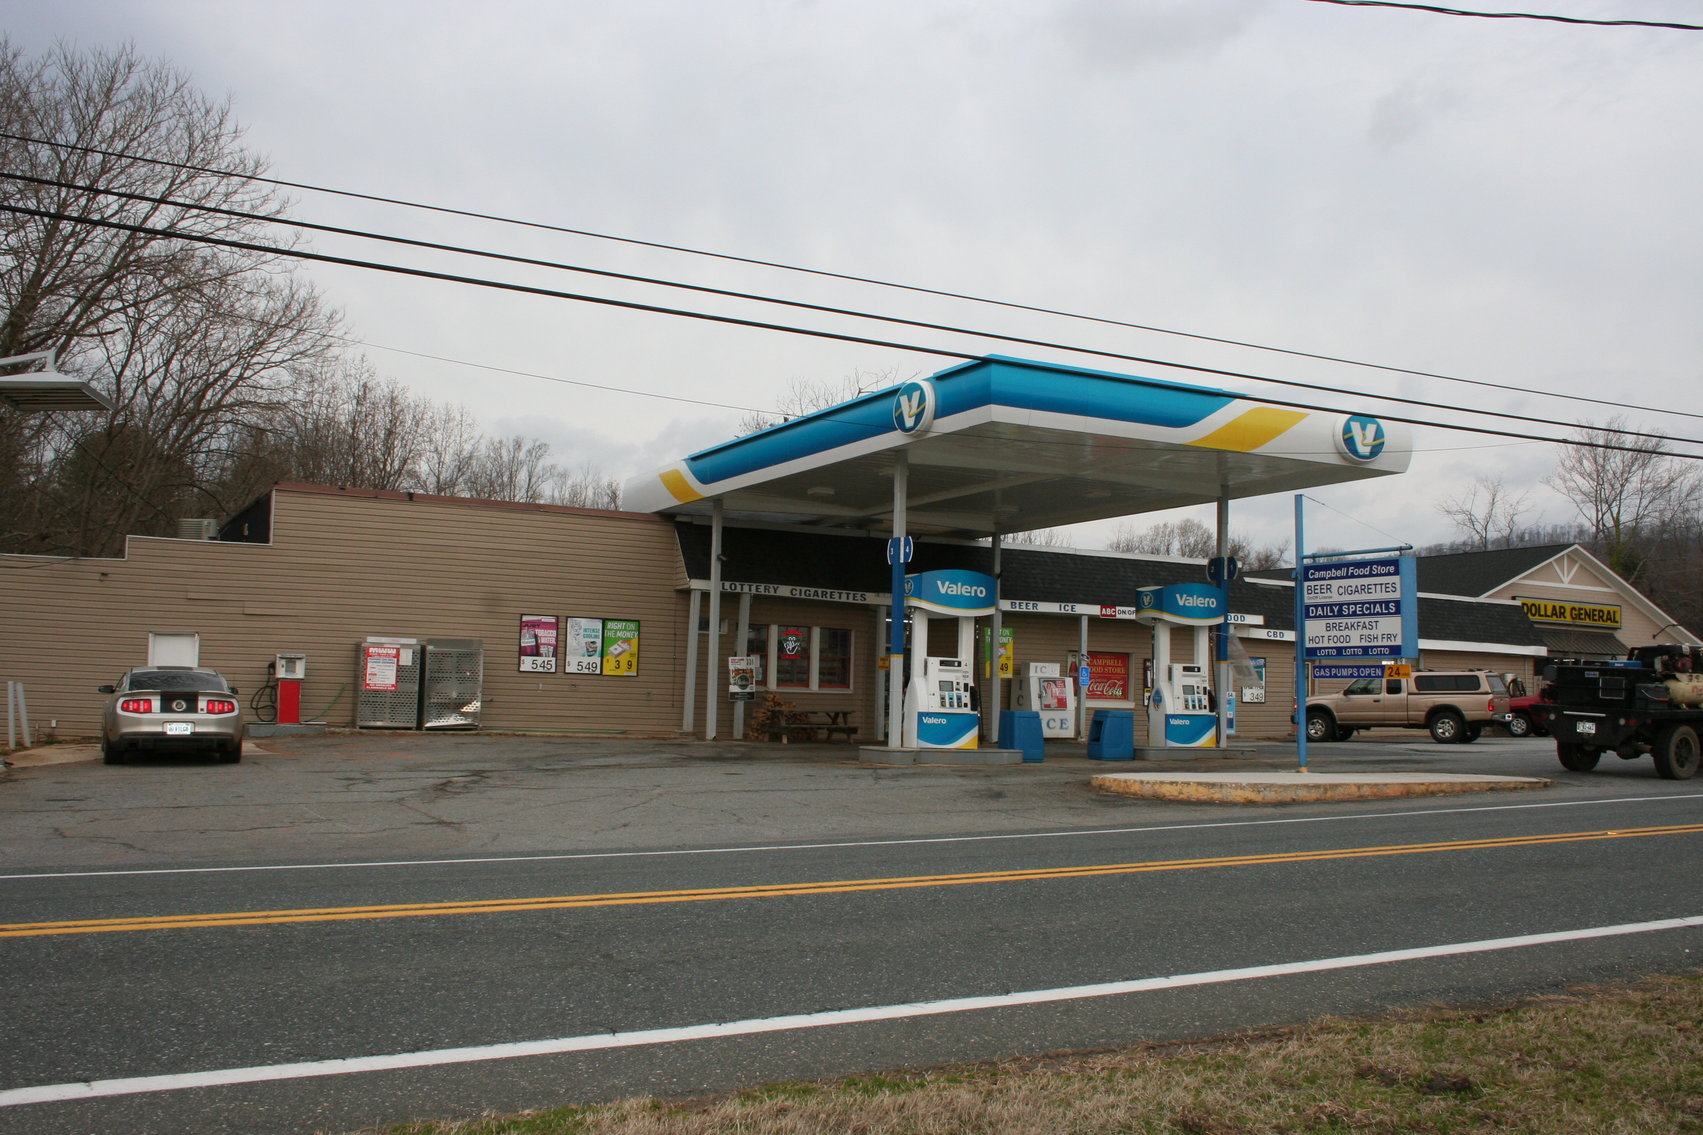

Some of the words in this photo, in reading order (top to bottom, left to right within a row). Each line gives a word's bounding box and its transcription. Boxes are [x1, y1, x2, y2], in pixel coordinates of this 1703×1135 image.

[1308, 567, 1347, 579] Campbell
[1348, 565, 1371, 576] Food
[1372, 564, 1395, 574] Store
[721, 582, 779, 594] LOTTERY
[790, 587, 867, 602] CIGARETTES
[936, 580, 986, 598] Valero
[1306, 583, 1333, 595] BEER
[1337, 582, 1397, 596] CIGARETTES
[1175, 593, 1217, 608] Valero
[1010, 601, 1039, 611] BEER
[1059, 604, 1077, 613] ICE
[1101, 607, 1116, 615] ABC
[1309, 605, 1339, 616] DAILY
[1342, 603, 1396, 615] SPECIALS
[1521, 602, 1567, 619] DOLLAR
[1570, 606, 1619, 623] GENERAL
[1227, 614, 1246, 622] OOD
[607, 622, 626, 630] RIGHT
[1325, 620, 1379, 632] BREAKFAST
[616, 630, 638, 638] MONEY
[1266, 630, 1285, 639] CBD
[1308, 635, 1325, 645] HOT
[1327, 634, 1351, 644] FOOD
[1359, 633, 1379, 643] FISH
[1381, 633, 1398, 642] FRY
[1368, 647, 1390, 655] LOTTO
[1104, 666, 1125, 674] STORE
[1314, 668, 1330, 676] GAS
[1331, 668, 1358, 676] PUMPS
[1359, 667, 1382, 676] OPEN
[1387, 667, 1400, 677] 24
[922, 716, 947, 724] Valero
[1042, 718, 1069, 730] CE
